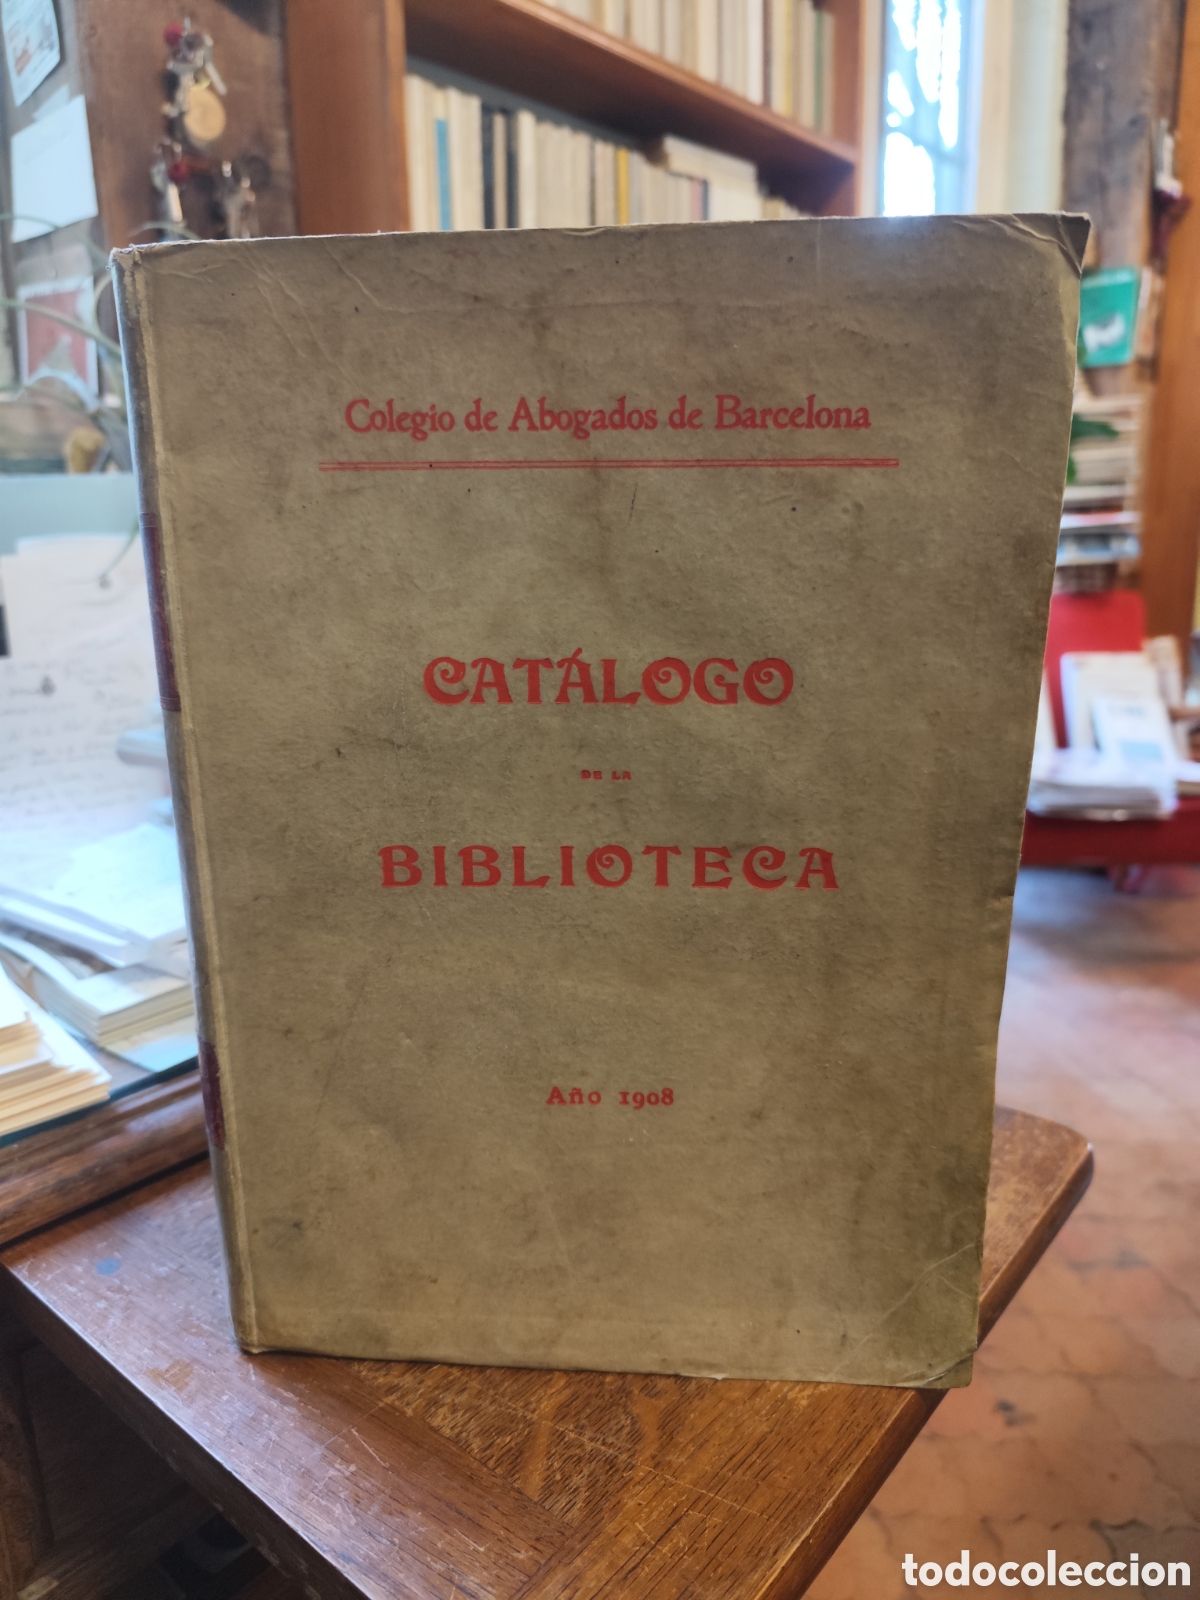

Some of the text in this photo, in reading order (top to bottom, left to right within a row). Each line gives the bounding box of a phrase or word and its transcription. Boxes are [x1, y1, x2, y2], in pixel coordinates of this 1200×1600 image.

[345, 394, 872, 442] Colegio de Abogados de Barcelona
[422, 647, 794, 707] CATÁLOGO
[580, 769, 632, 781] DE LA
[377, 844, 839, 891] BIBLIOTECA
[545, 1085, 675, 1111] Año 1908
